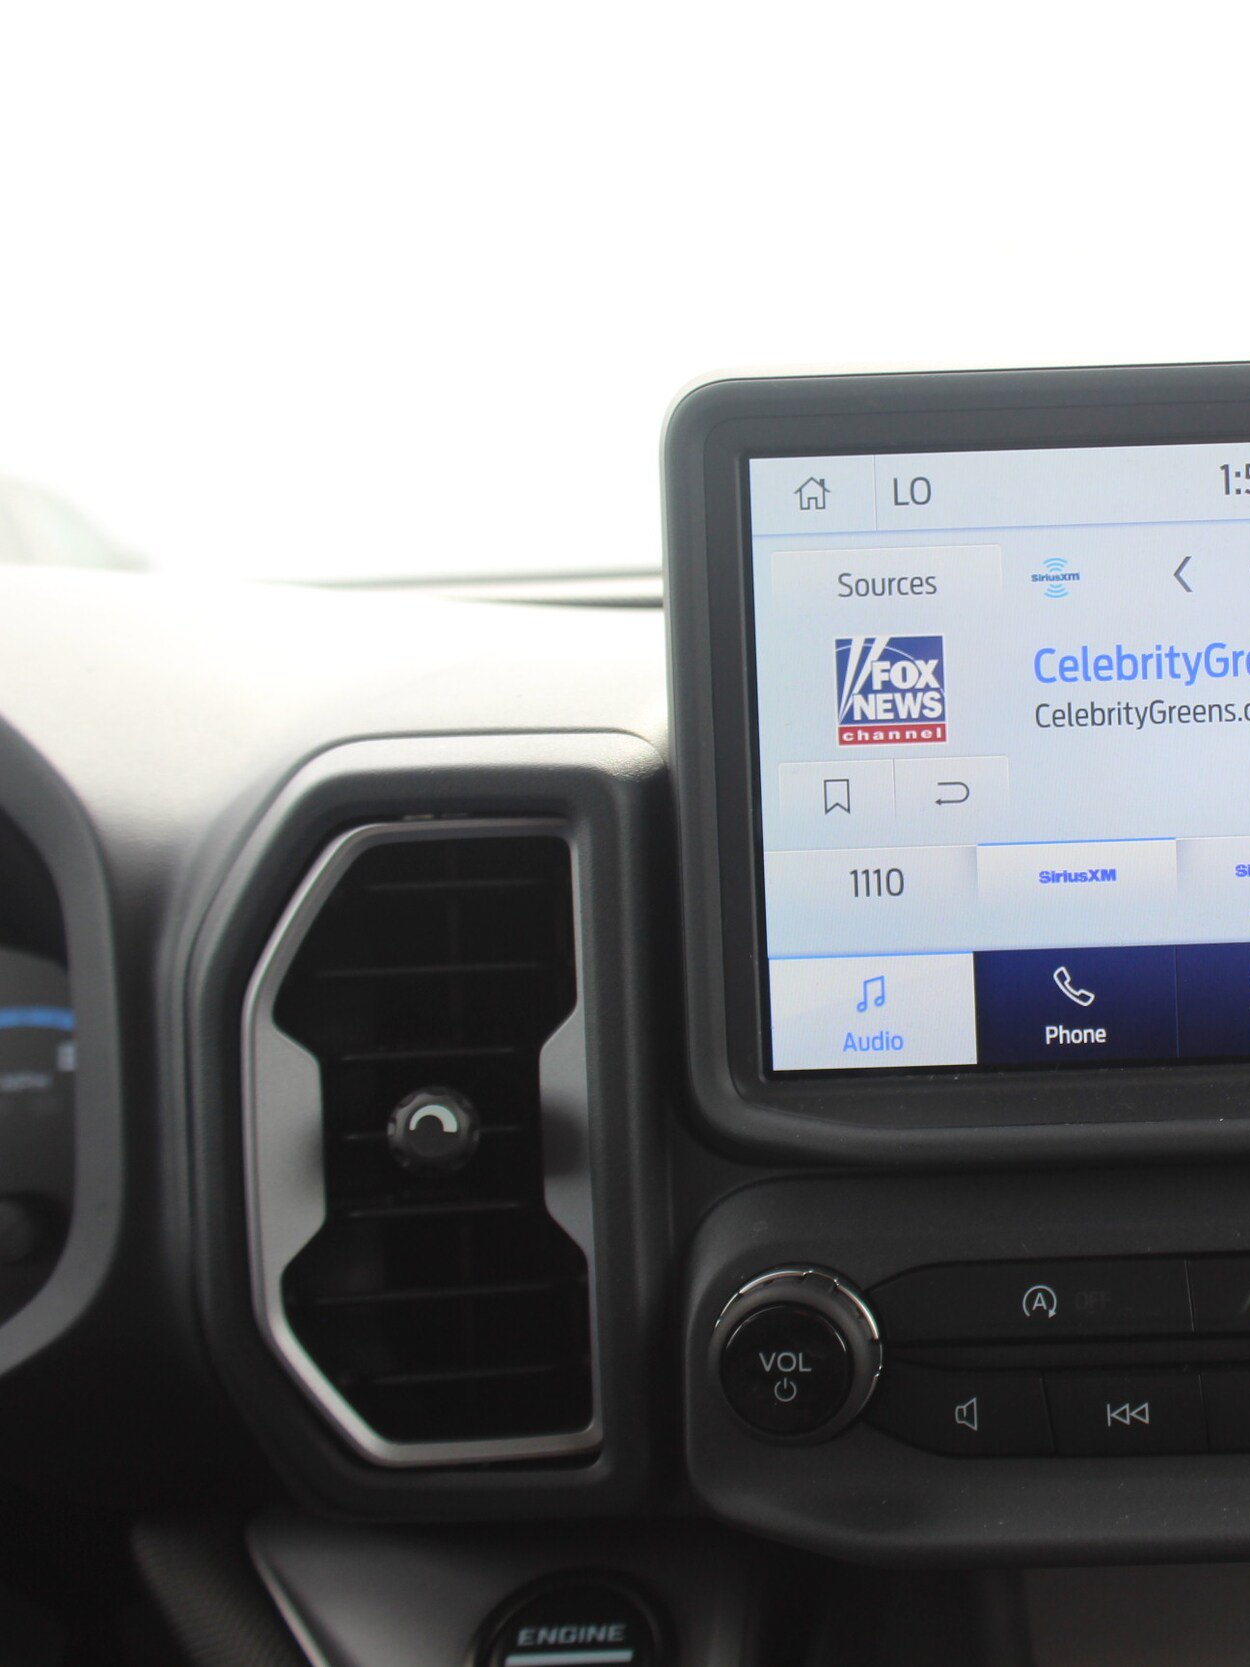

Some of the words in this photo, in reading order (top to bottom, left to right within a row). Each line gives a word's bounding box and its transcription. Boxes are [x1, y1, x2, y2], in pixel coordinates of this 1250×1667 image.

[894, 477, 931, 505] LO
[838, 573, 937, 597] Sources
[1031, 572, 1080, 583] SiriusXM
[871, 659, 941, 691] FOX
[852, 691, 943, 721] NEWS
[842, 726, 943, 742] channel
[850, 868, 904, 897] 1110
[1039, 869, 1116, 883] SiriusXM
[843, 1031, 903, 1052] Audio
[1046, 1025, 1106, 1044] Phone
[759, 1352, 811, 1372] VOL
[517, 1623, 627, 1646] ENGINE
